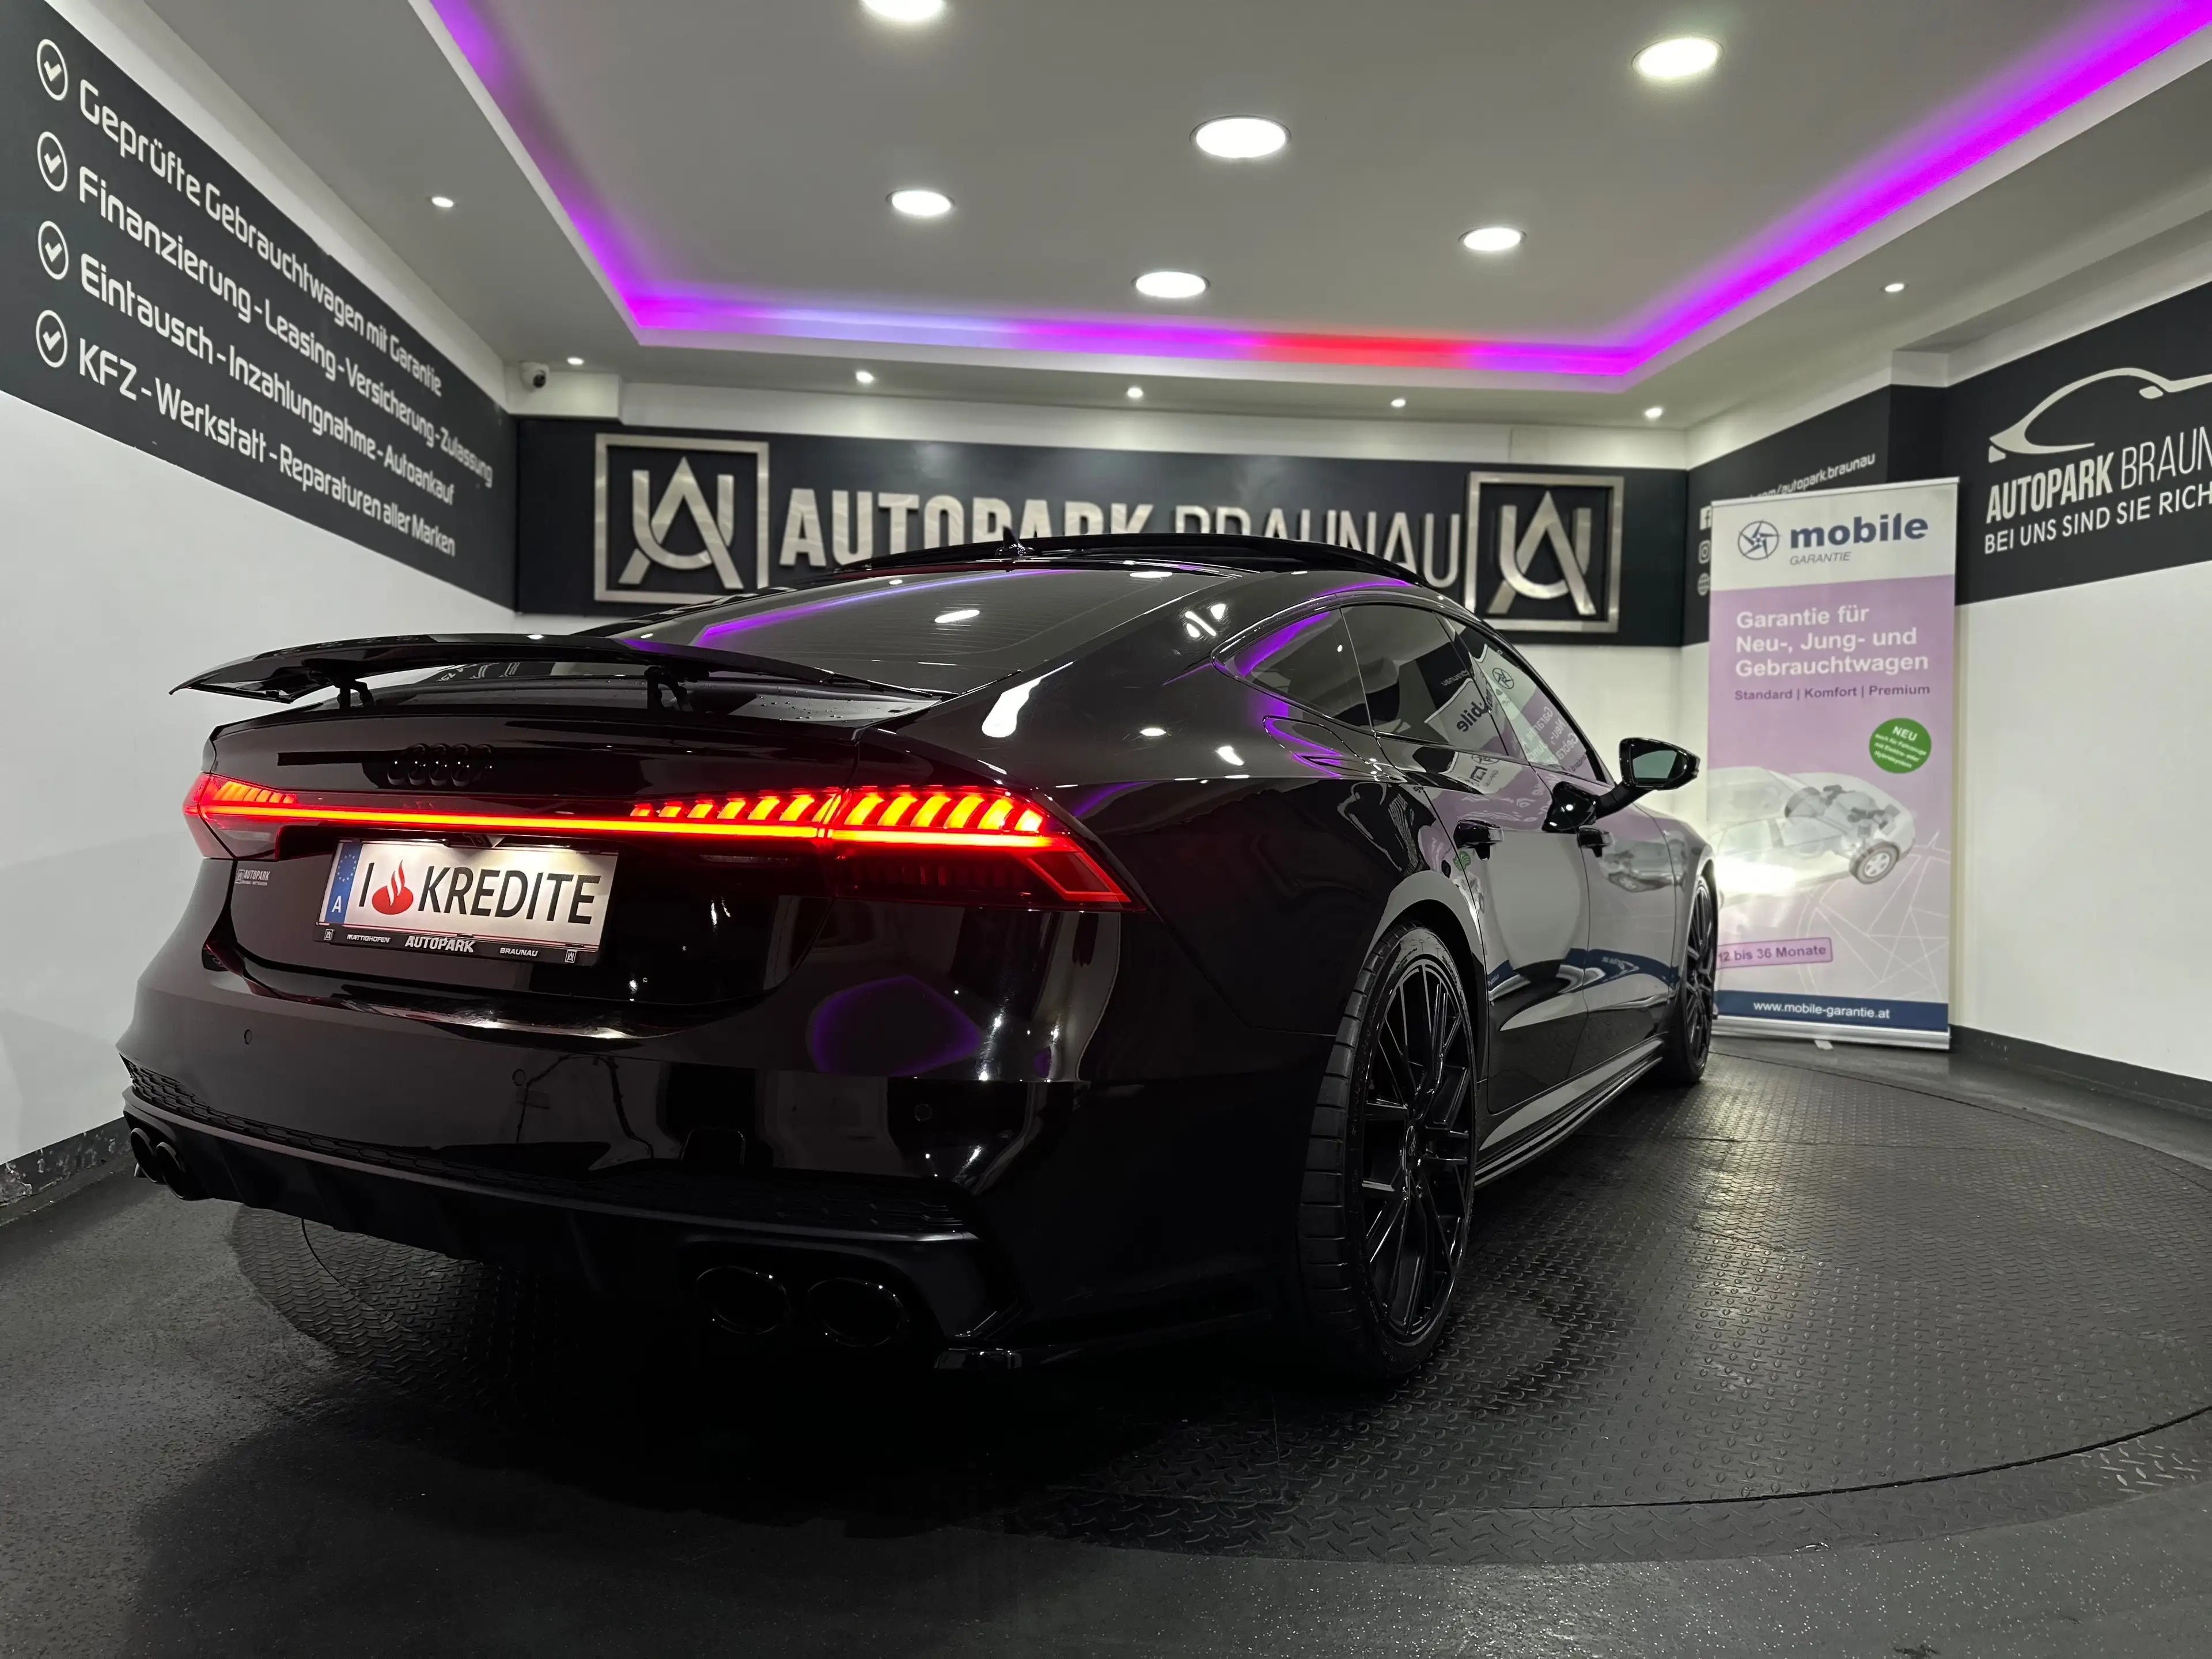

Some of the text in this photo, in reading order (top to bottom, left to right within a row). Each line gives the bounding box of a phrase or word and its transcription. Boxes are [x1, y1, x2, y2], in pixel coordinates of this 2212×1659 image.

[79, 78, 442, 397] Geprüfte Gebrauchtwagen mit Garantie
[1986, 451, 2115, 525] AUTOPARK
[382, 502, 411, 535] aller
[411, 513, 456, 557] Marken
[1790, 512, 1929, 550] mobile
[1984, 528, 2014, 555] BEI
[2020, 518, 2058, 547] UNS
[2062, 506, 2111, 537] SIND
[2116, 495, 2152, 525] SIE
[1790, 551, 1851, 565] GARANTIE
[1736, 604, 1870, 629] Garantie für
[1735, 627, 1917, 654] Neu-, Jung- und
[1734, 655, 1929, 677] Gebrauchtwagen
[1734, 688, 1793, 701] Standard
[1804, 686, 1858, 699] Komfort
[1869, 684, 1931, 696] Premium
[1892, 726, 1918, 741] NEU
[243, 869, 271, 881] AUTOPARK
[331, 862, 601, 925] A I KREDITE
[346, 933, 392, 944] MATTIGHOFEN
[404, 935, 476, 953] AUTOPARK
[499, 947, 539, 957] BRAUNAU
[1717, 945, 1827, 963] 12 bis 36 Monate
[1753, 1002, 1891, 1019] www.mobile-garantie.at
